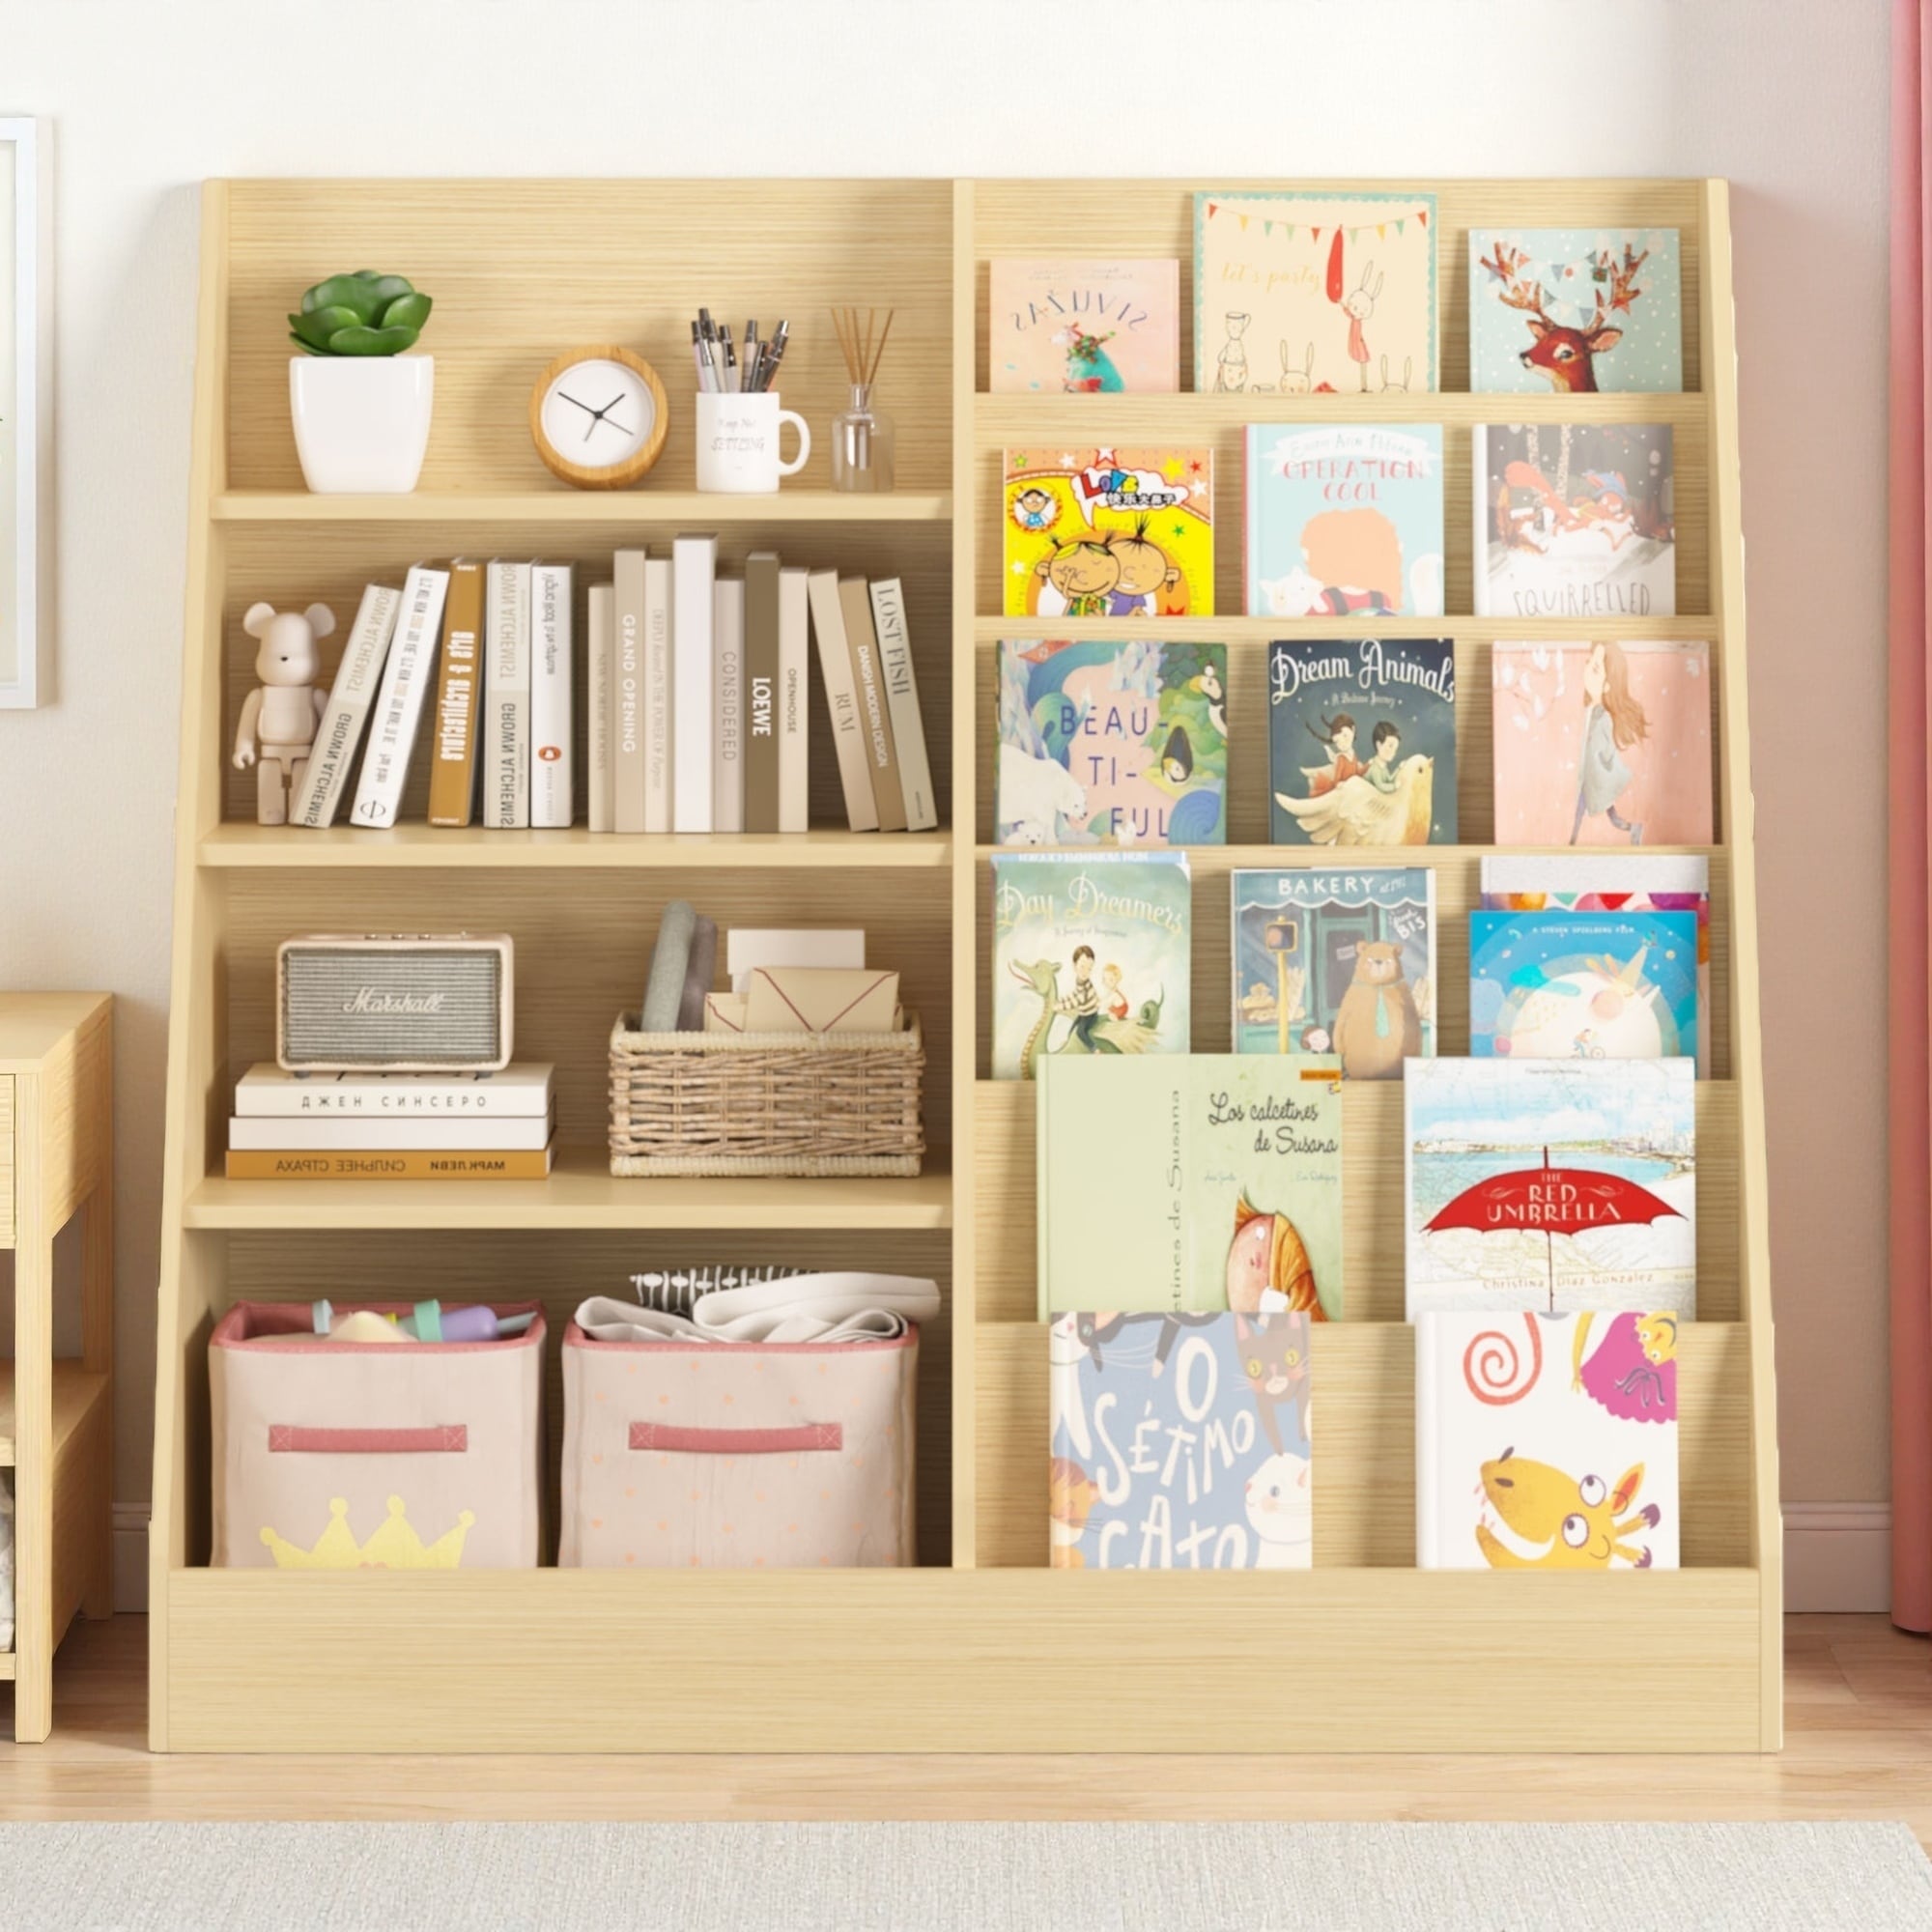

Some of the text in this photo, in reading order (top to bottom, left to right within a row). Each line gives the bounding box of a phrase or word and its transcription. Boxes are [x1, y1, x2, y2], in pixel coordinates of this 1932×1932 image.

[1283, 459, 1425, 479] OPERATION
[1323, 482, 1381, 501] COOL
[1513, 581, 1651, 616] SQUIRRELLED
[876, 587, 910, 696] LOST FISH
[622, 614, 636, 753] GRAND OPENING
[1270, 639, 1455, 705] Dream Animals
[722, 652, 736, 761] CONSIDERED
[753, 677, 771, 736] LOEWE
[787, 668, 797, 734] OPENHOUSE
[1111, 808, 1169, 838] FUL
[1278, 876, 1374, 895] BAKERY
[996, 870, 1183, 936] Day Dreamers
[343, 986, 444, 1013] Marshall
[302, 1096, 486, 1108] ДЖЕН СИНСЕРО
[1208, 1092, 1319, 1125] Los calcetines
[1166, 1090, 1183, 1192] Susana
[1254, 1125, 1339, 1154] de Susana
[1541, 1173, 1562, 1182] THE
[1528, 1184, 1577, 1203] RED
[1167, 1200, 1180, 1231] de
[1487, 1203, 1622, 1225] UMBRELLA
[1483, 1276, 1545, 1290] Christina
[1592, 1272, 1655, 1287] Gonzalez
[1175, 1336, 1218, 1423] O
